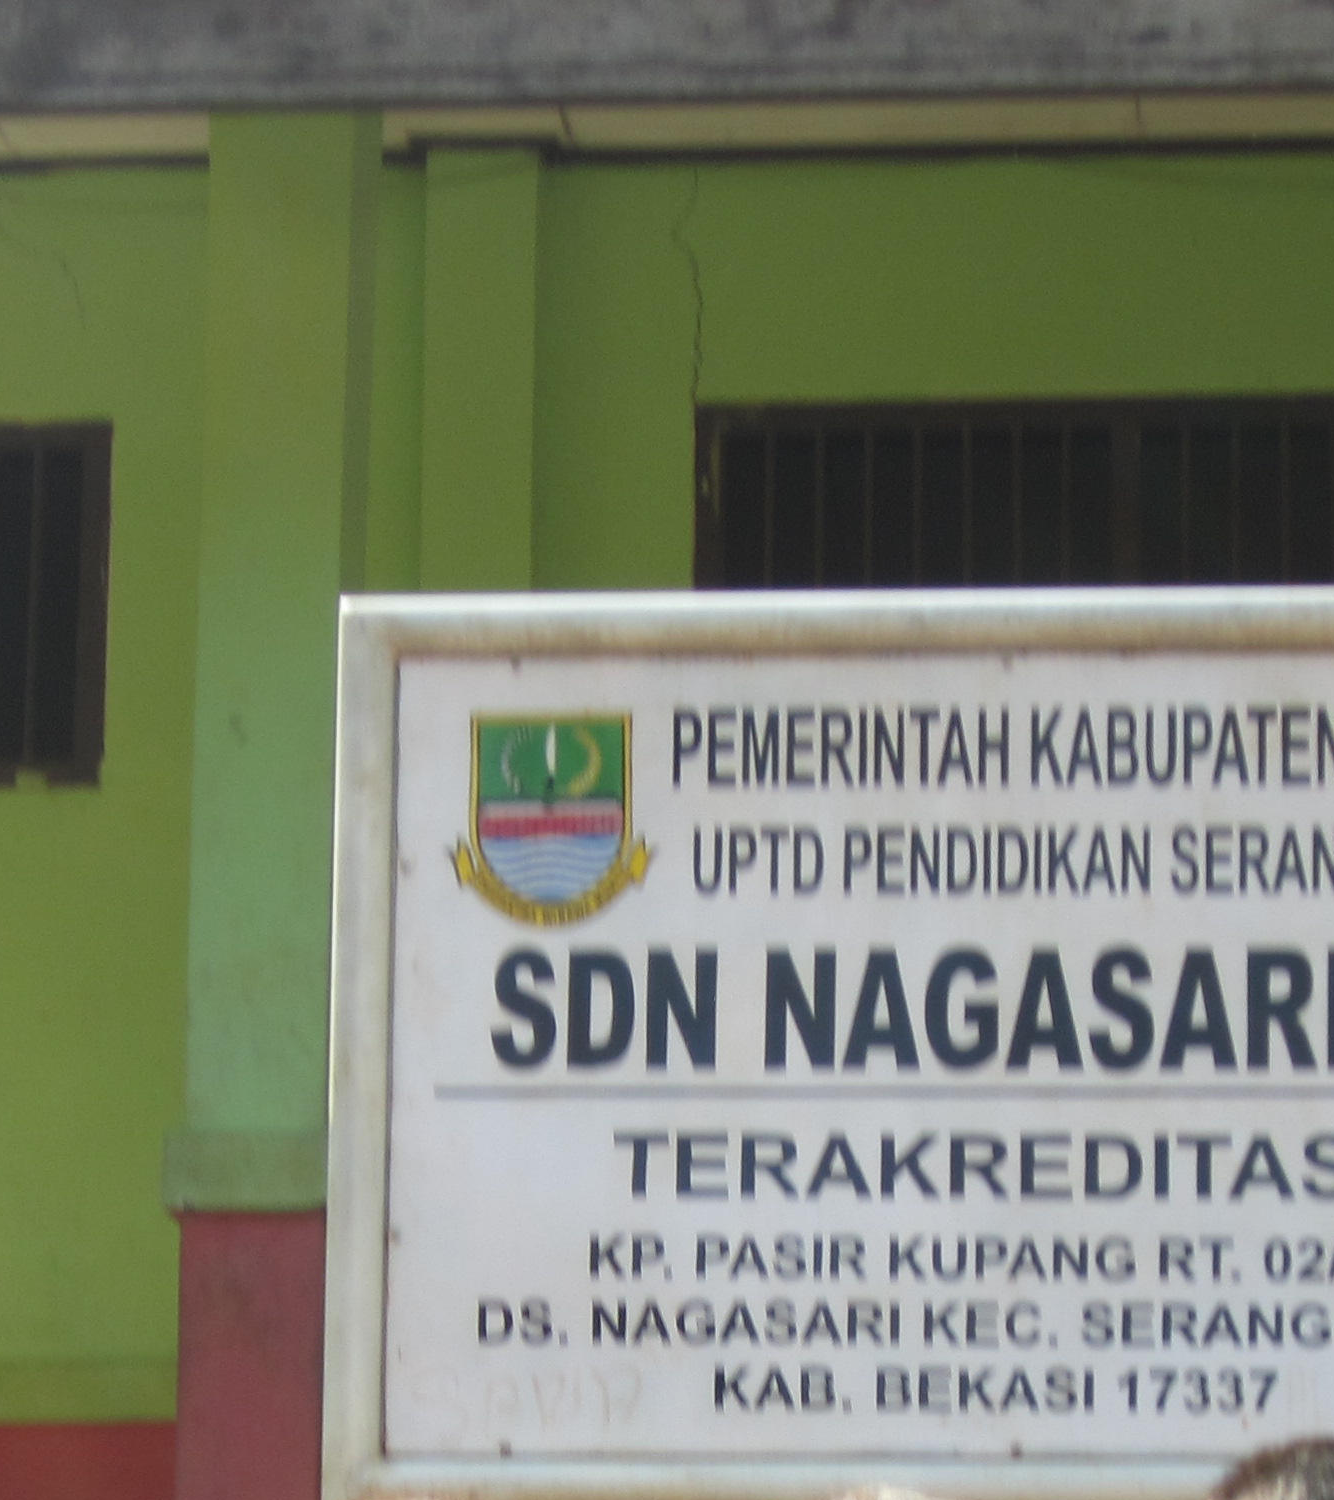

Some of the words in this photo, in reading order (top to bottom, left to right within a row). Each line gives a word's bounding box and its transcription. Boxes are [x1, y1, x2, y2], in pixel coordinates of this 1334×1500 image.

[672, 705, 1010, 789] PEMERINTAH
[692, 824, 825, 897] UPTD
[842, 824, 1151, 897] PENDIDIKAN
[490, 944, 719, 1073] SDN
[588, 1234, 672, 1280] KP.
[695, 1234, 866, 1280] PASIR
[888, 1235, 1137, 1282] KUPANG
[1158, 1236, 1240, 1283] RT.
[477, 1300, 568, 1345] DS.
[591, 1299, 901, 1346] NAGASARI
[922, 1301, 1057, 1347] KEC.
[1082, 1302, 1332, 1349] SERANG
[713, 1364, 851, 1411] KAB.
[875, 1366, 1095, 1413] BEKASI
[1118, 1367, 1279, 1415] 17337
